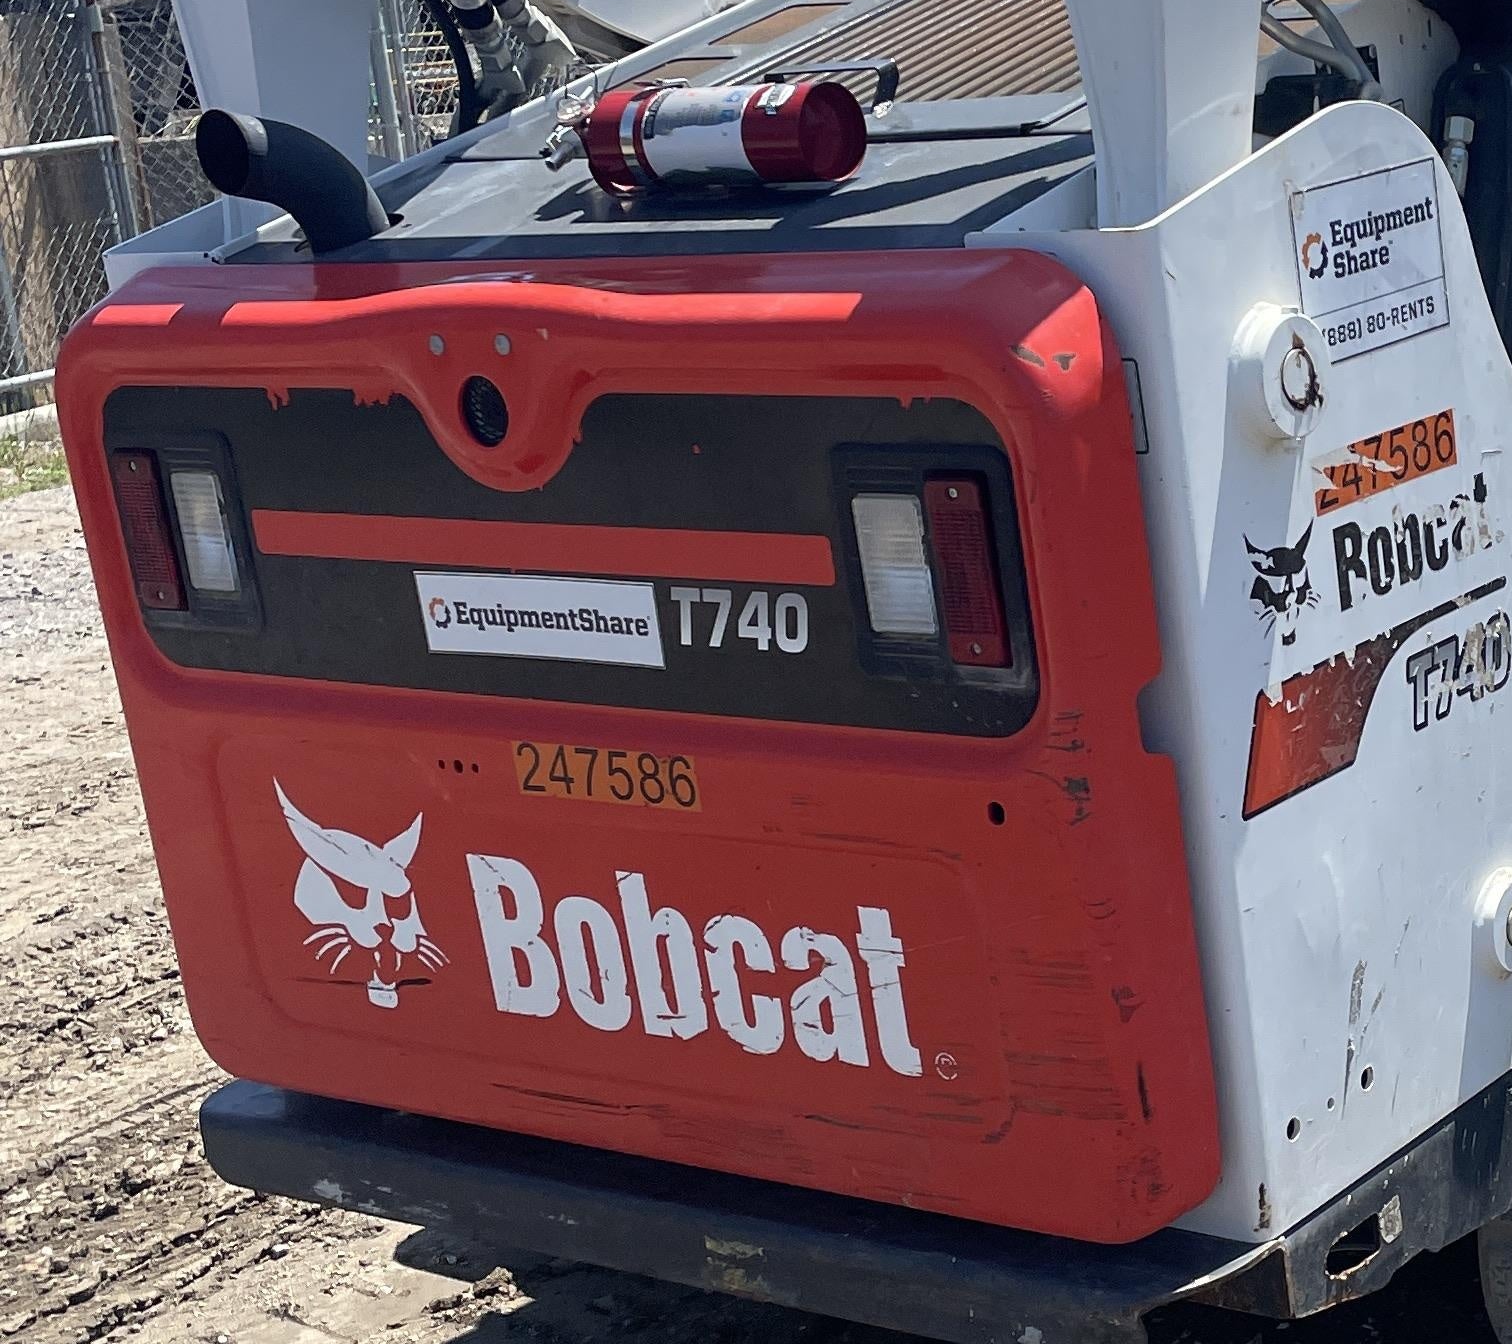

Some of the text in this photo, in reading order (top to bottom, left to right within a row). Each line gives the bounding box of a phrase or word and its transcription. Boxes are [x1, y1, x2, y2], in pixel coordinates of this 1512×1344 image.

[1329, 196, 1434, 249] Equipment
[1333, 245, 1391, 279] Share
[1366, 295, 1435, 335] 80-RENTS
[453, 600, 650, 639] EquipmentShare
[670, 586, 809, 654] T740
[1405, 607, 1512, 733] T740
[515, 741, 697, 807] 247586
[465, 852, 924, 1078] Bobcat
